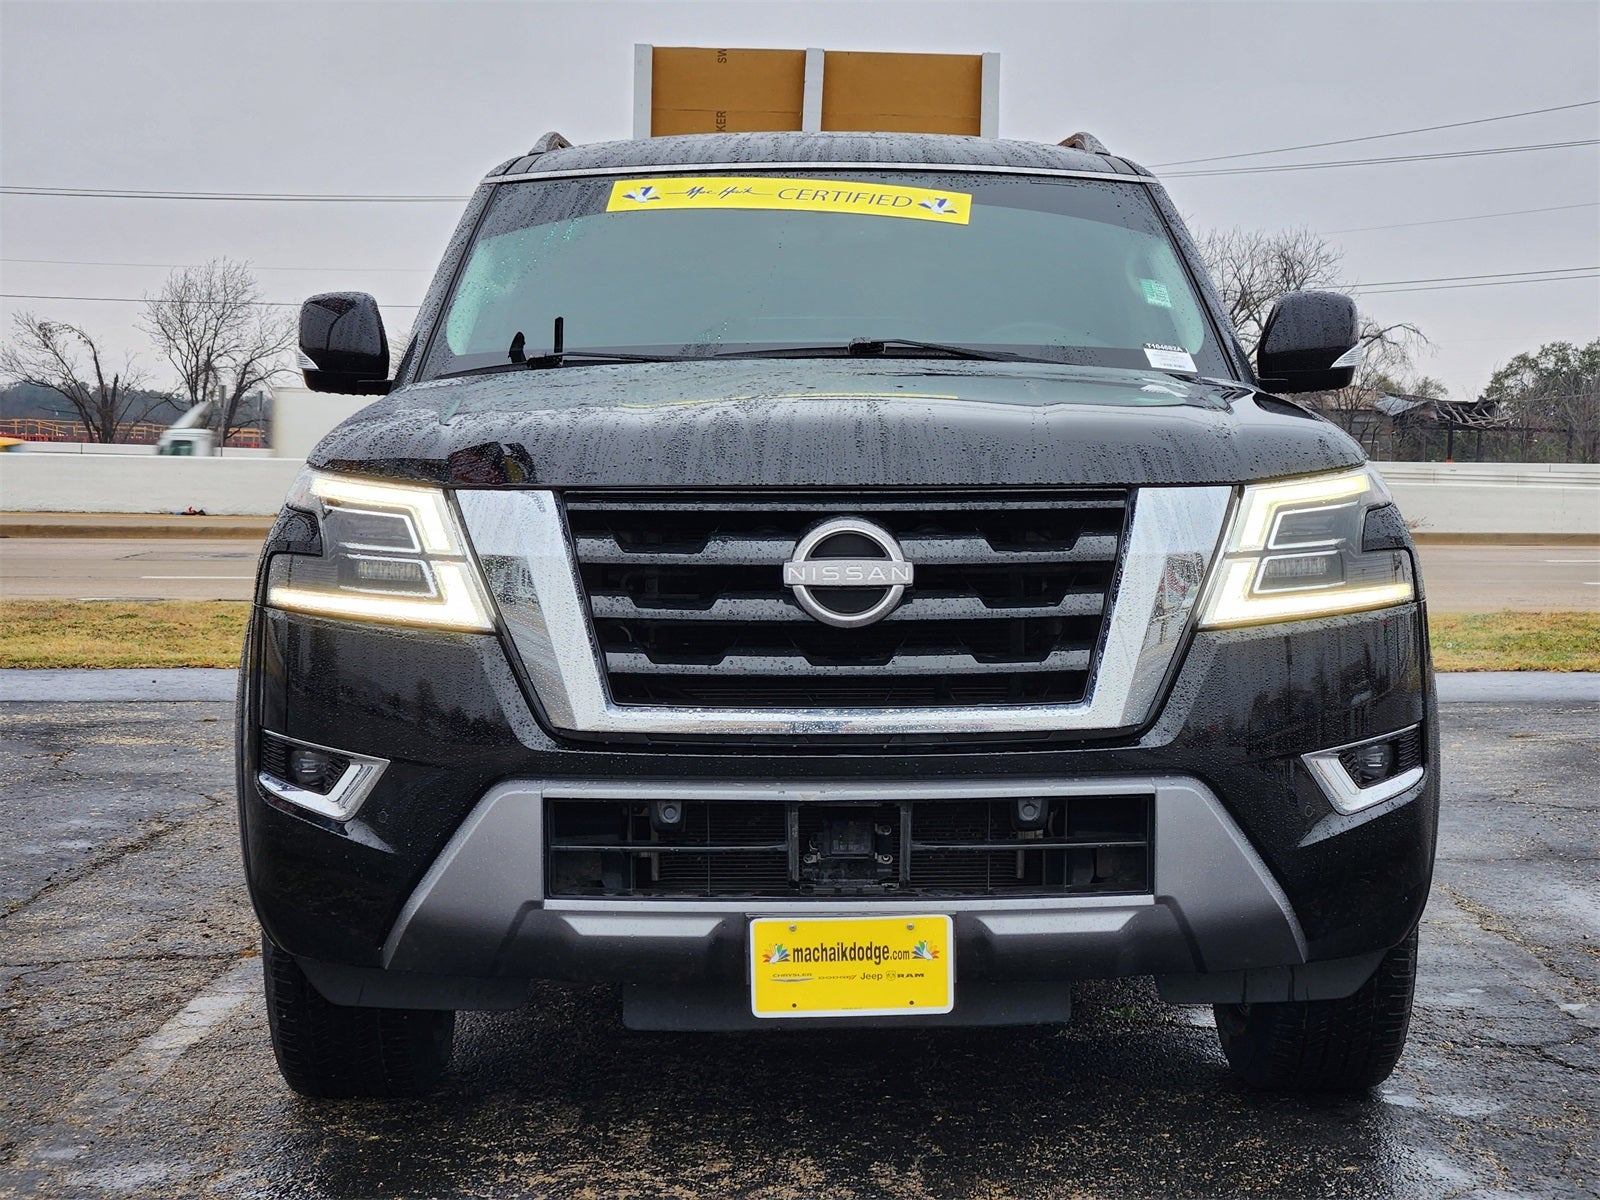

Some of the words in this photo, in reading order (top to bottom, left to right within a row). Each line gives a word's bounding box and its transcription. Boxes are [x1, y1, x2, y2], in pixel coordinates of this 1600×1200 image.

[777, 188, 913, 208] CERTIFIED
[787, 566, 909, 581] NISSAN
[792, 941, 910, 966] machaikdodge.com
[860, 972, 883, 981] Jeep
